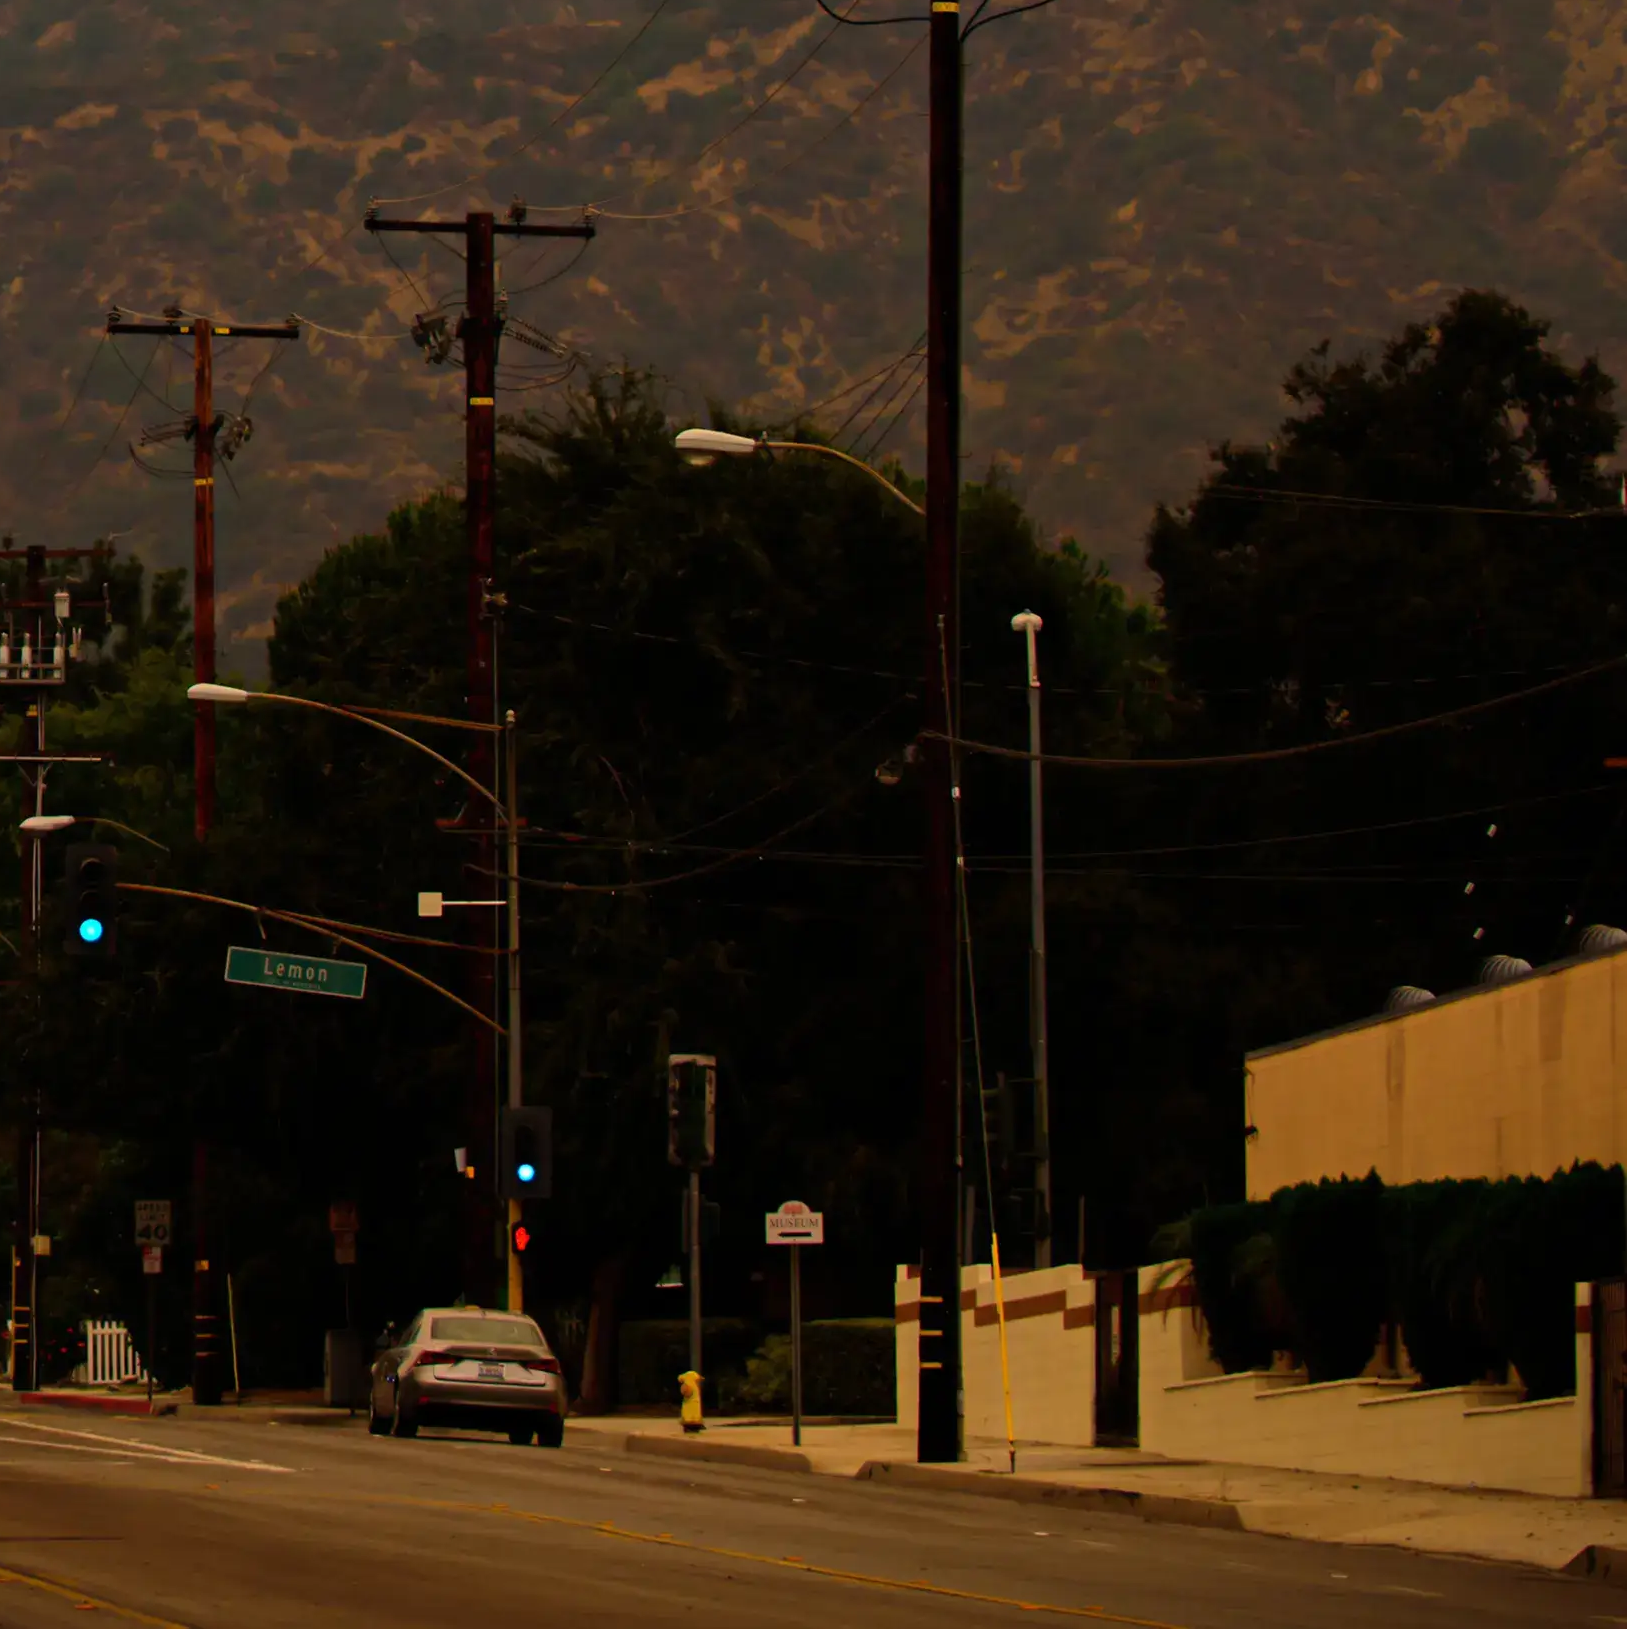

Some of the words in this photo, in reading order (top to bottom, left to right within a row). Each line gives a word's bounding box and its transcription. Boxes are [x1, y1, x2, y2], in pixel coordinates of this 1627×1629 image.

[264, 957, 328, 981] Lemon
[138, 1223, 167, 1240] 40
[770, 1219, 818, 1228] MUSEUM
